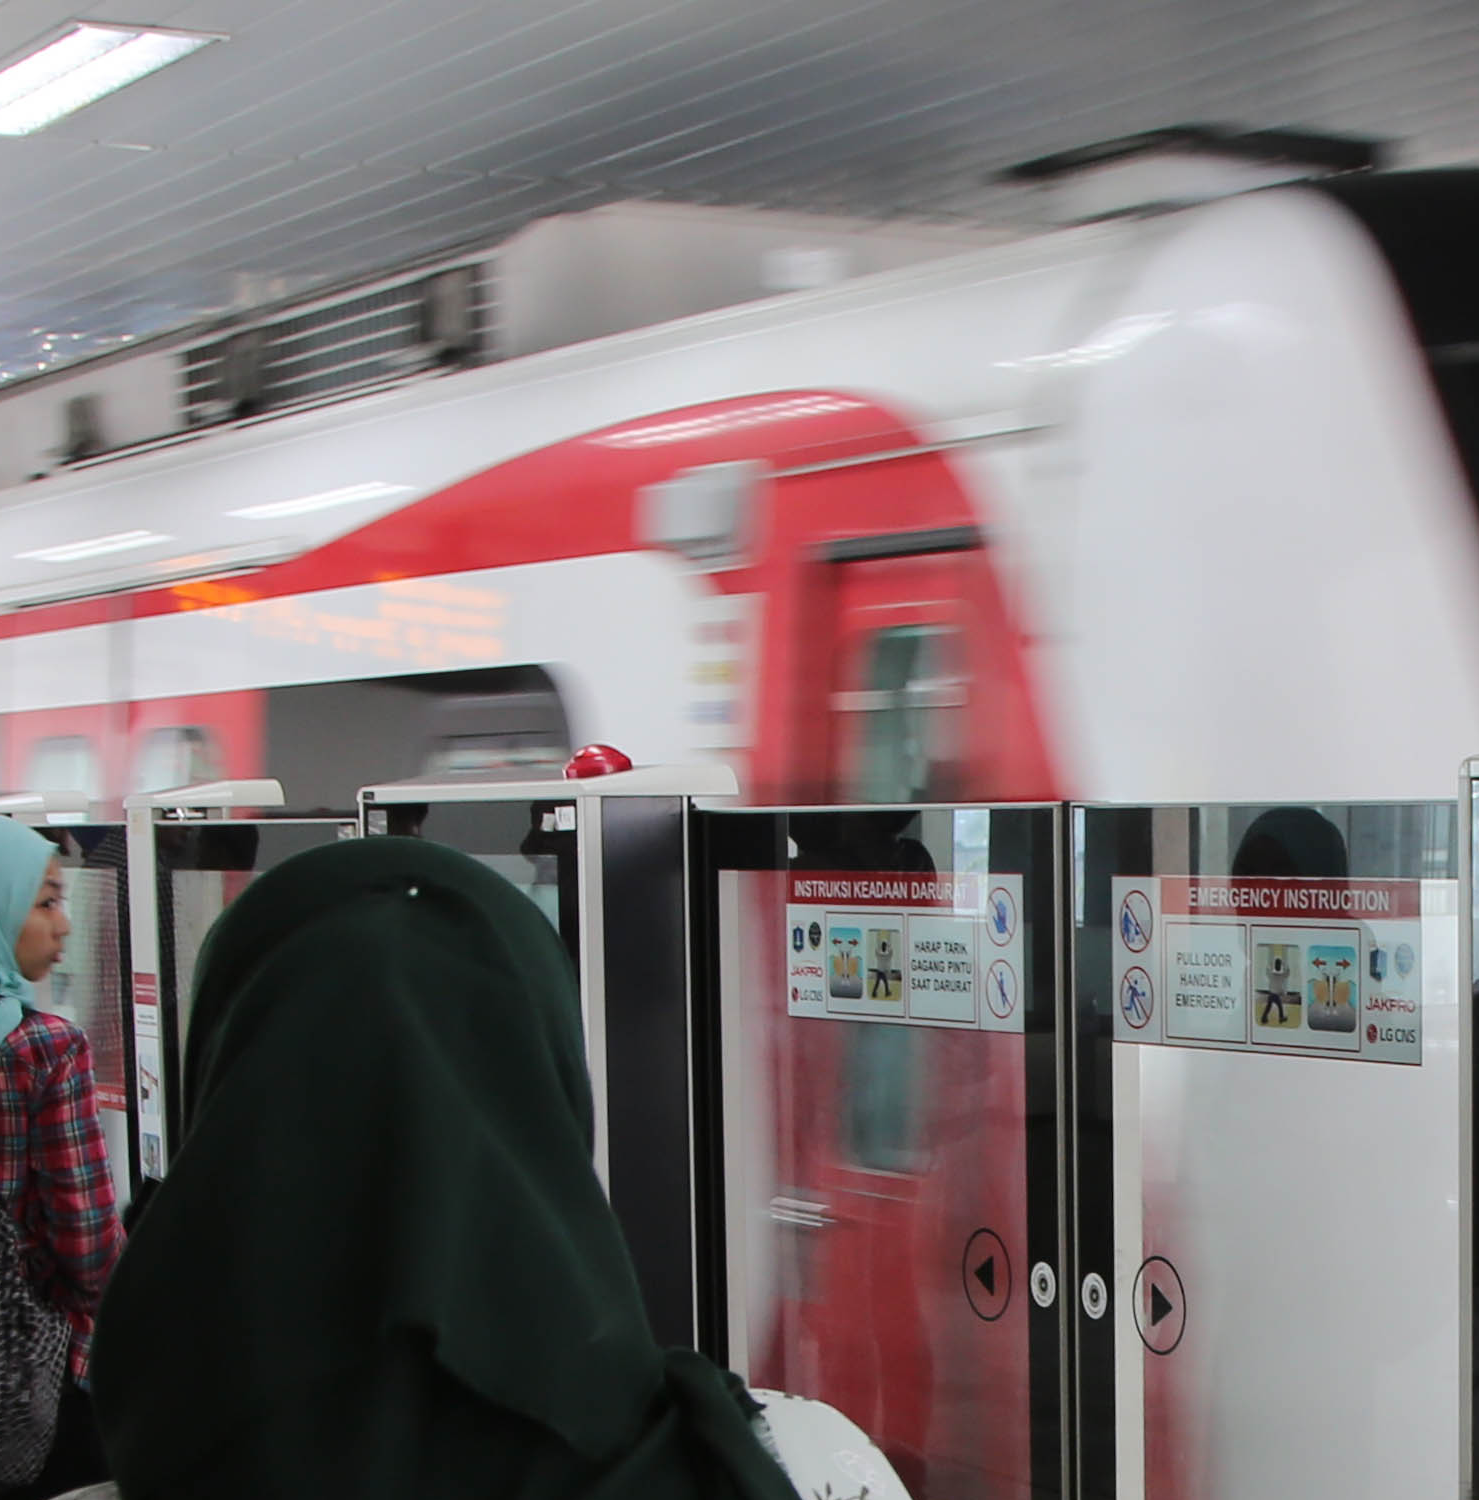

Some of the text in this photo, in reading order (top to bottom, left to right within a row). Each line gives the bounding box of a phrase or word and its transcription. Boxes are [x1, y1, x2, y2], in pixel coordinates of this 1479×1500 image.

[794, 880, 852, 899] INSTRUKSI
[853, 881, 908, 900] KEADAAN
[1188, 886, 1390, 912] EMERGENCY INSTRUCTION
[914, 941, 942, 953] HARAP
[1176, 952, 1233, 968] PULL DOOR
[1180, 973, 1219, 988] HANDLE
[1175, 993, 1237, 1010] EMERGENCY
[1365, 994, 1417, 1013] JAKPRO
[1379, 1027, 1394, 1042] LG
